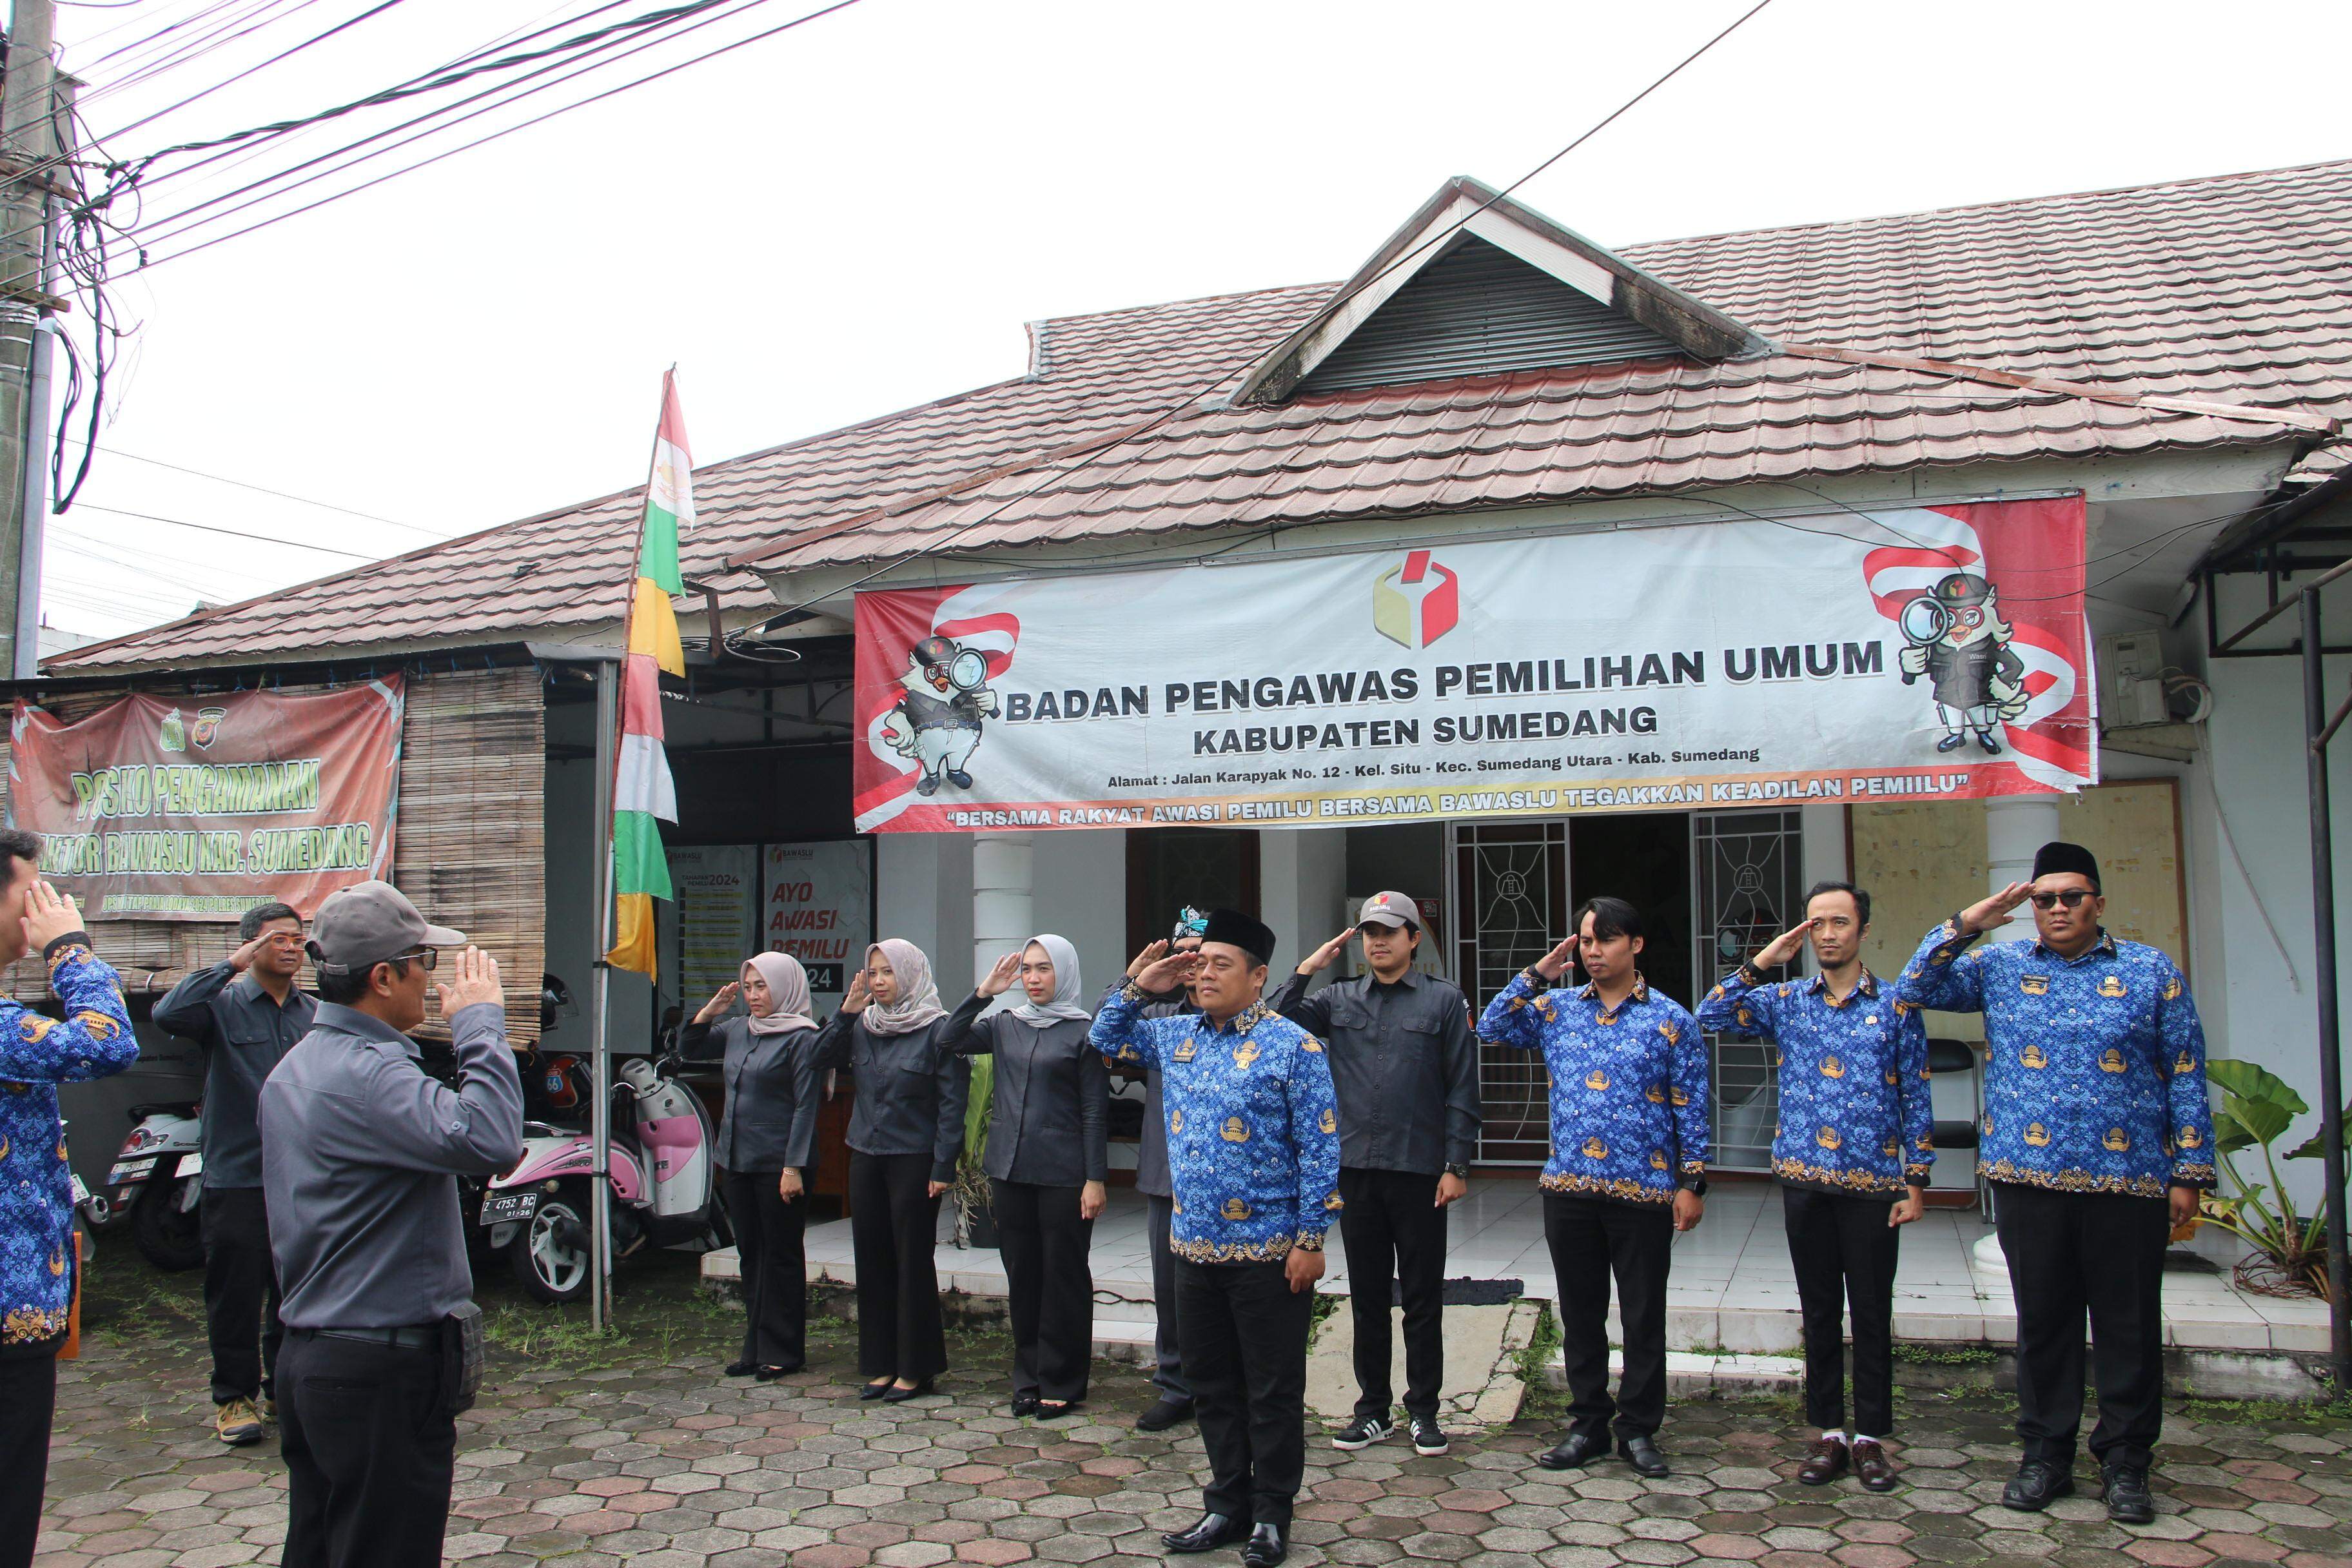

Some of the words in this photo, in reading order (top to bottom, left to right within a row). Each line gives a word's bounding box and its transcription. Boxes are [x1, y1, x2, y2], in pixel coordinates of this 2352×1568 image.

[1006, 685, 1149, 721] BADAN
[1166, 668, 1420, 712] PENGAWAS
[1435, 651, 1705, 697] PEMILIHAN
[1725, 640, 1883, 681] UMUM
[1194, 719, 1419, 755] KABUPATEN
[1433, 706, 1658, 743] SUMEDANG
[1108, 775, 1158, 788] Alamat
[1171, 774, 1211, 785] Jalan
[1216, 770, 1288, 784] Karapyak
[1292, 768, 1317, 779] No.
[1322, 767, 1340, 778] 12
[1355, 765, 1385, 776] Kel.
[1390, 763, 1420, 774] Situ
[1436, 761, 1472, 773] Kec.
[1477, 757, 1561, 770] Sumedang
[1567, 755, 1612, 767] Utara
[1628, 752, 1666, 765] Kab.
[1671, 748, 1760, 762] Sumedang
[73, 765, 150, 820] POSKO
[154, 759, 320, 818] PENGAMANAN
[947, 809, 1052, 827] “BERSAMA
[1058, 807, 1144, 824] RAKYAT
[1151, 803, 1220, 823] AWASI
[1227, 800, 1312, 820] PEMILU
[1319, 796, 1433, 816] BERSAMA
[1439, 789, 1557, 812] BAWASLU
[1563, 783, 1703, 807] TEGAKKAN
[1711, 778, 1843, 801] KEADILAN
[39, 833, 103, 876] ANTOR
[105, 830, 197, 875] BAWASLU
[198, 831, 245, 875] KAB.
[248, 823, 371, 874] SUMEDANG
[709, 874, 740, 886] 2024
[771, 882, 813, 903] AYO
[769, 910, 838, 930] AWASI
[771, 939, 850, 959] PEMILU
[807, 968, 832, 988] 24
[484, 1202, 490, 1211] Z
[495, 1198, 517, 1210] 4752
[522, 1196, 534, 1206] BC
